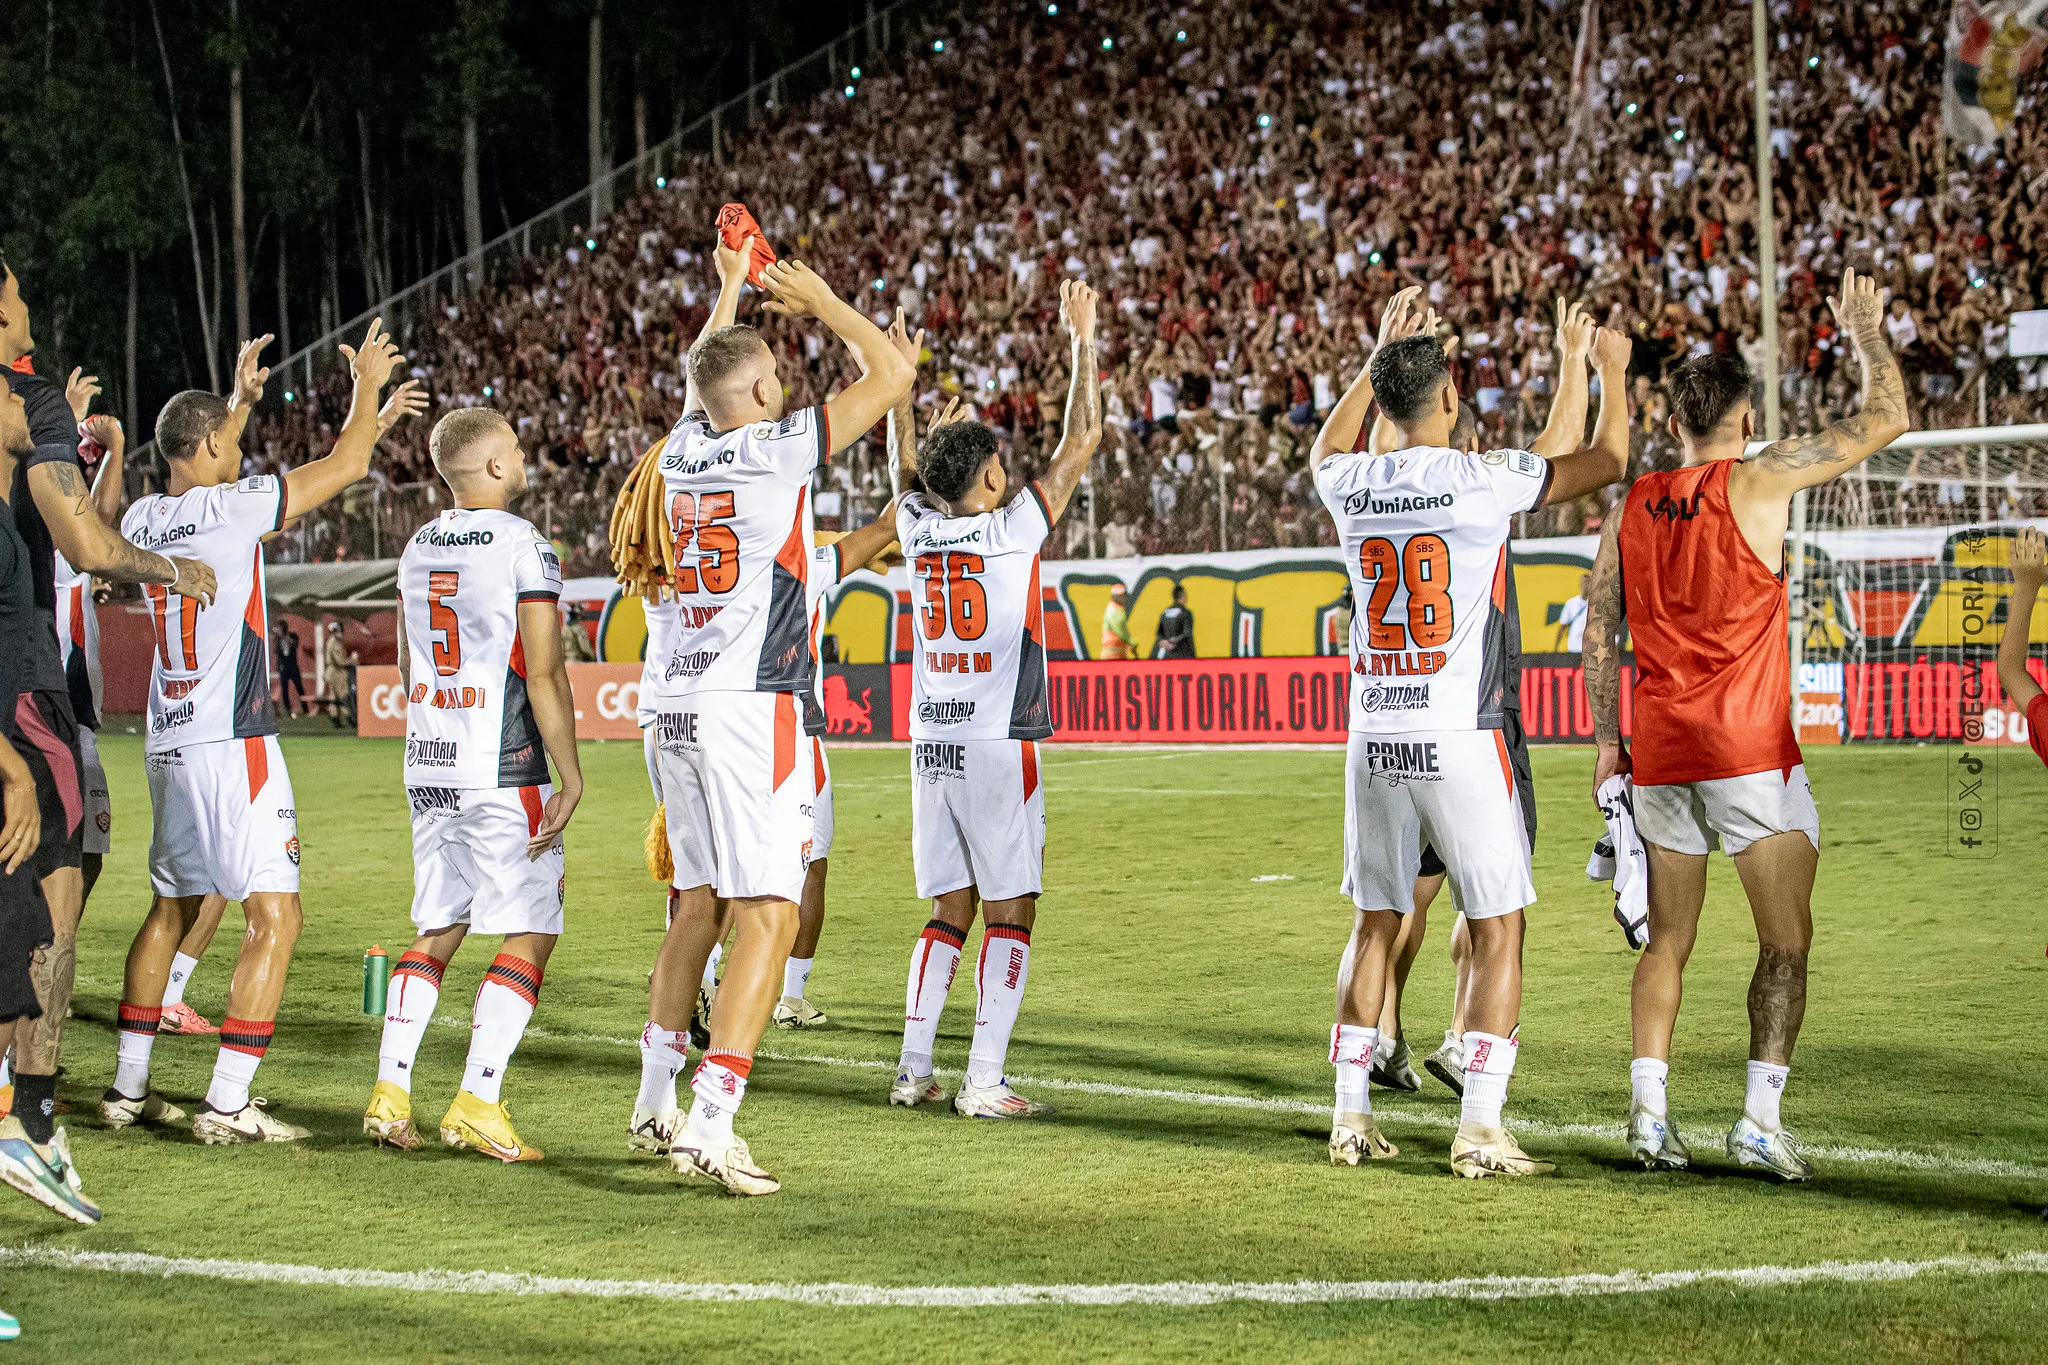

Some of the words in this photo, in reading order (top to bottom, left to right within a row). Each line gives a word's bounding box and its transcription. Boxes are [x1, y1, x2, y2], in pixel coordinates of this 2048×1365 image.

[1372, 493, 1454, 514] UniAGRO
[672, 489, 740, 594] 25
[1416, 543, 1434, 554] SBS
[915, 550, 988, 641] 36
[1360, 533, 1455, 651] 28
[427, 570, 461, 677] 5
[925, 652, 969, 673] FILIPE
[973, 652, 992, 673] M
[1354, 651, 1447, 676] R.RYLLER
[1380, 702, 1430, 711] PREMIA
[419, 736, 457, 760] VITÓRIA
[916, 743, 966, 772] PRIME
[1366, 741, 1440, 773] PRIME
[417, 759, 457, 768] PREMIA
[1365, 753, 1446, 789] Regulariza
[1004, 946, 1024, 990] UniBARTER
